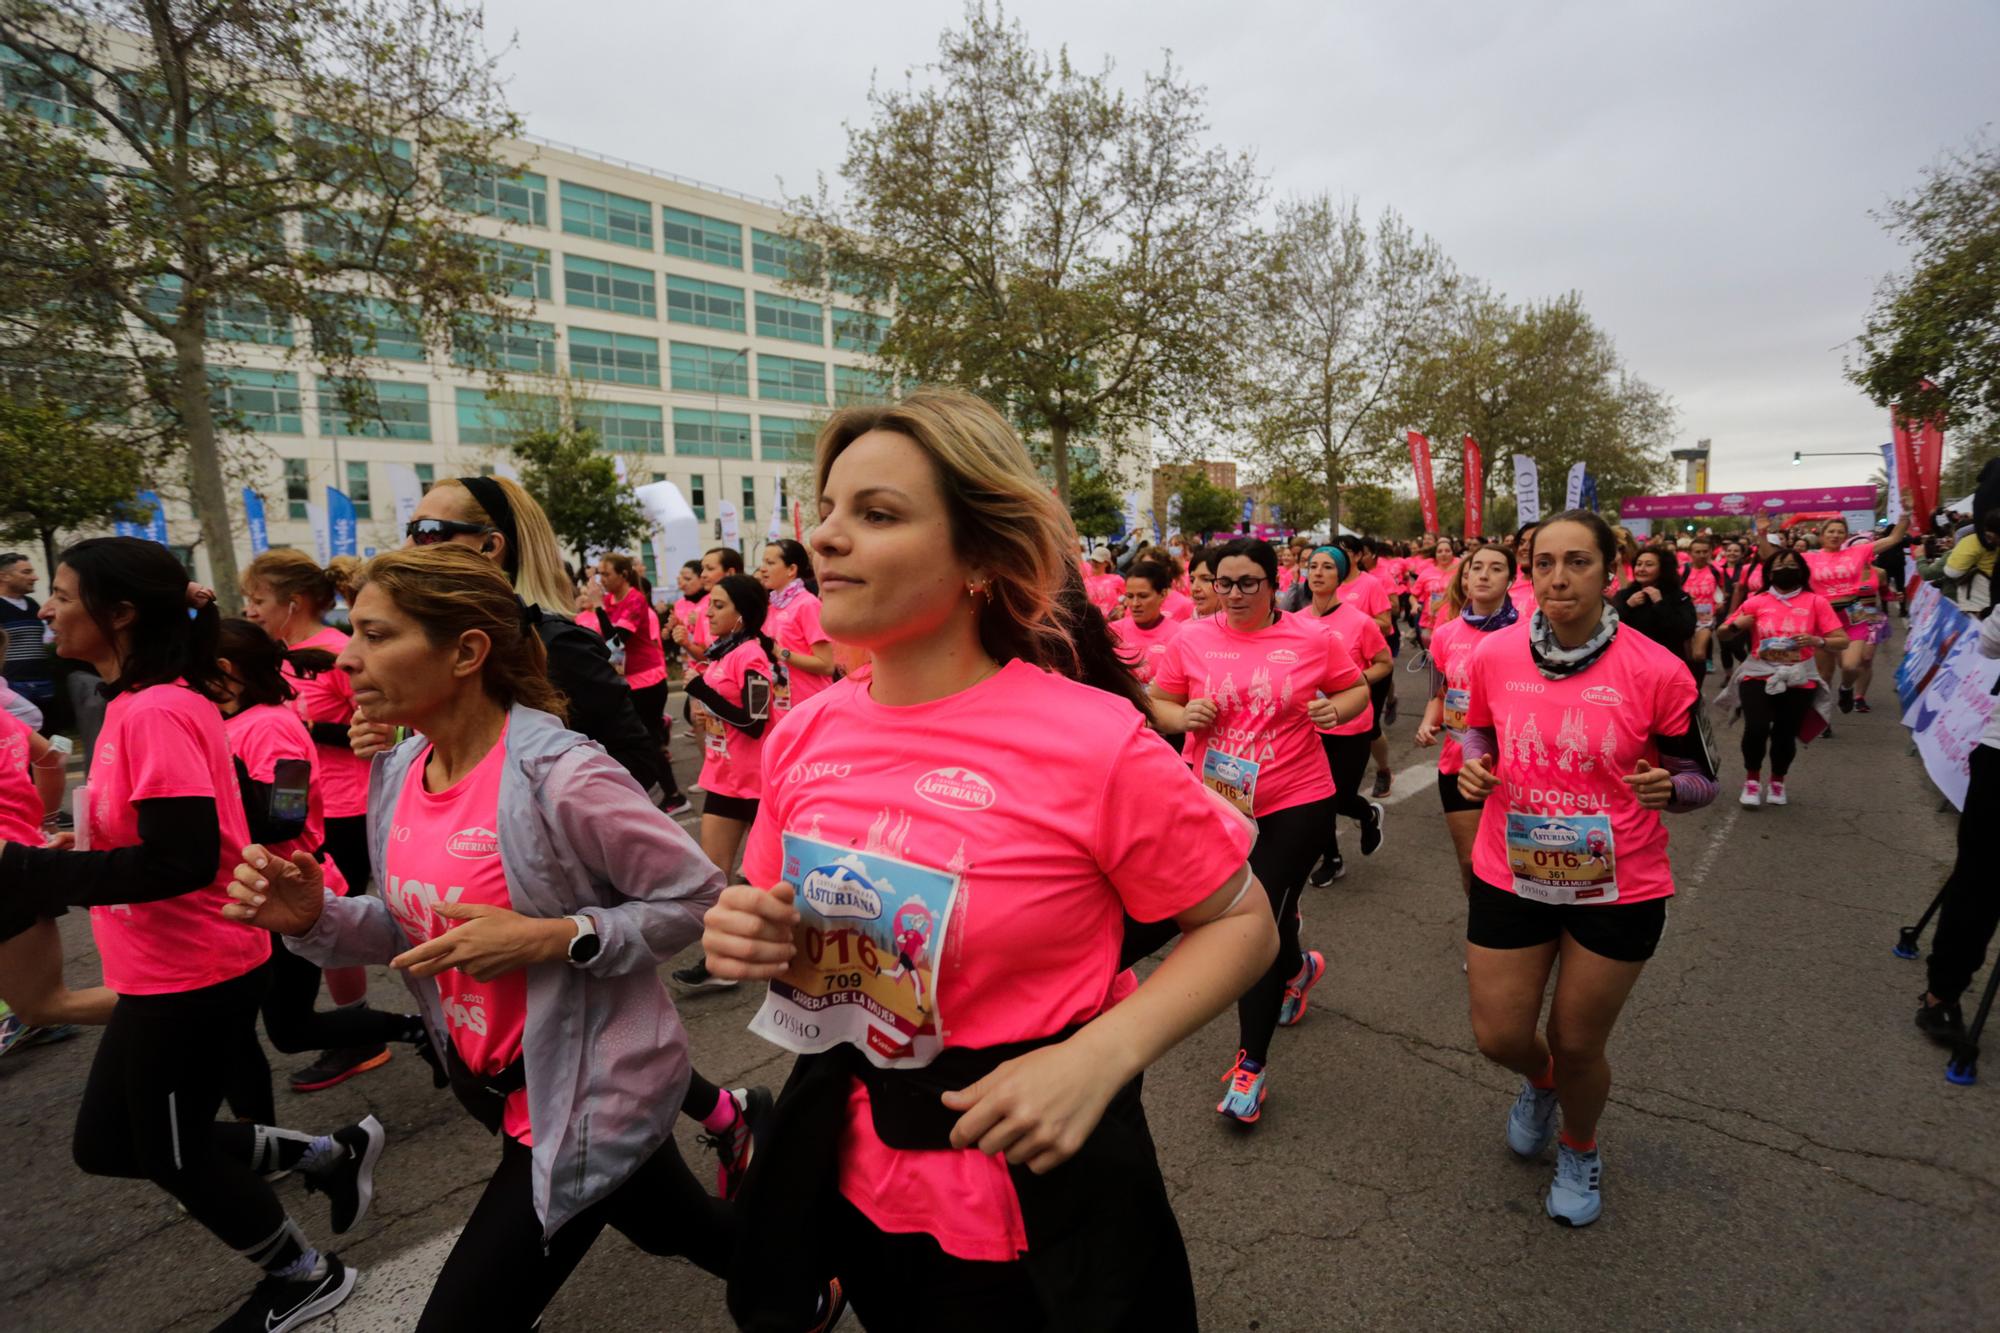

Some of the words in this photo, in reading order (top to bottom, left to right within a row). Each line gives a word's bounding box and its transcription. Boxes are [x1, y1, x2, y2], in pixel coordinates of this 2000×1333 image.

[1505, 681, 1545, 694] OYSHO
[1227, 727, 1276, 742] DORA
[789, 762, 852, 784] OYSHO
[920, 777, 987, 806] ASTURIANA
[1216, 781, 1237, 799] 016
[1529, 788, 1612, 809] DORSAL
[1534, 831, 1576, 842] ASTURIANA
[1533, 849, 1578, 868] 016
[1549, 870, 1565, 879] 361
[806, 879, 876, 915] ASTURIANA
[806, 926, 878, 972] 016
[824, 972, 862, 990] 709
[832, 992, 849, 1004] DE
[852, 991, 865, 1006] LA
[867, 998, 896, 1026] MUJER
[773, 1008, 821, 1040] OYSHO
